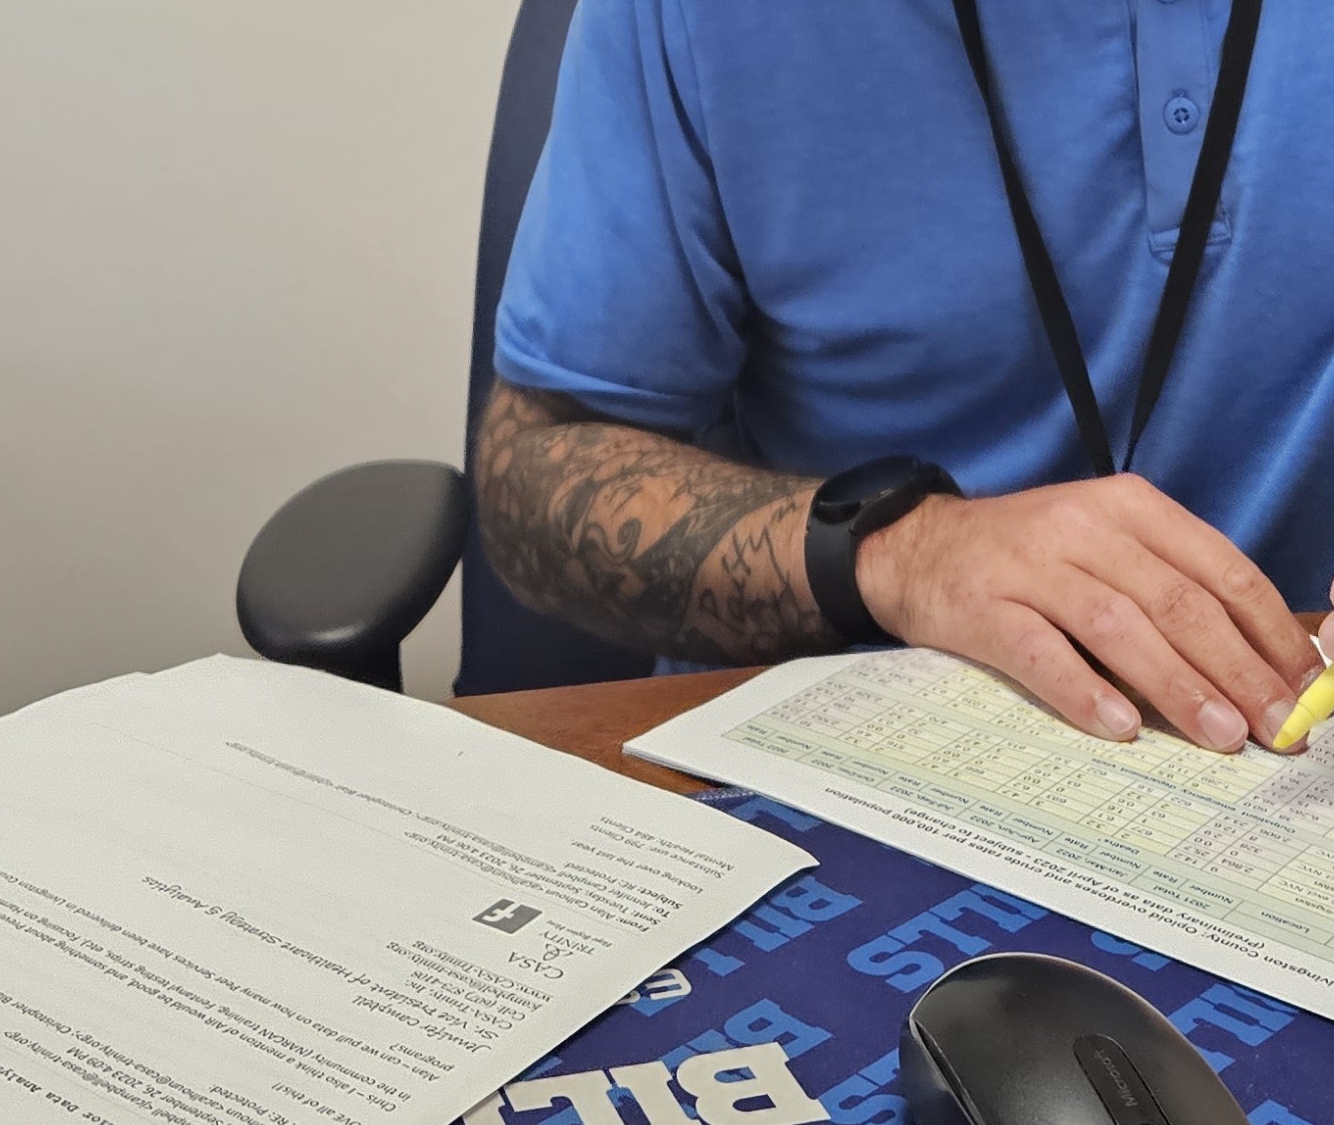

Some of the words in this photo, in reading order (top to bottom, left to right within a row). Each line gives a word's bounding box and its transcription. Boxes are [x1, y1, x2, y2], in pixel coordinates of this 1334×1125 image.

[897, 775, 922, 787] Rate
[824, 787, 894, 816] population
[929, 787, 970, 805] Number
[903, 807, 957, 831] change)
[979, 804, 1004, 817] Rate
[890, 813, 940, 835] 100,000
[969, 814, 996, 828] 2022
[1012, 817, 1054, 837] Number
[941, 832, 968, 845] per
[957, 828, 973, 838] to
[967, 841, 1003, 858] rates
[972, 833, 1025, 857] subject
[1063, 837, 1089, 850] Rate
[1055, 848, 1083, 861] 2022
[1098, 850, 1142, 870] Number
[1003, 855, 1044, 874] crude
[1032, 857, 1068, 874] 2023
[1042, 871, 1073, 885] and
[1066, 870, 1104, 887] April
[1152, 870, 1179, 884] Rate
[17, 880, 68, 907] Livingston
[141, 876, 210, 909] Analytics
[1073, 882, 1148, 914] overdoses
[1101, 884, 1120, 894] of
[1122, 891, 1141, 901] as
[1152, 884, 1181, 900] Total
[1189, 884, 1234, 905] Number
[64, 901, 79, 911] in
[544, 888, 590, 909] Calhoun
[1141, 898, 1174, 914] data
[1183, 896, 1211, 910] 2021
[72, 906, 123, 933] delivered
[588, 904, 617, 921] Alan
[218, 910, 283, 945] Strategy
[615, 917, 651, 933] From:
[1147, 911, 1199, 935] Opioid
[1175, 912, 1266, 950] (Preliminary
[1260, 911, 1311, 934] Location
[23, 926, 57, 944] about
[120, 929, 149, 947] been
[538, 930, 596, 956] TRINITY
[52, 939, 109, 971] something
[146, 942, 175, 960] have
[1200, 933, 1260, 959] County:
[171, 954, 217, 980] Services
[279, 941, 354, 979] Healthcare
[507, 950, 565, 980] CASA
[102, 967, 129, 981] and
[346, 972, 372, 986] of
[411, 939, 554, 1003] www.CASA-Trinity.org
[126, 977, 162, 997] good,
[213, 976, 242, 992] Peer
[404, 979, 428, 995] Inc.
[156, 993, 174, 1006] be
[239, 987, 272, 1005] many
[369, 982, 438, 1017] President
[9, 1001, 73, 1035] Christopher
[169, 1000, 207, 1021] would
[269, 1002, 297, 1019] how
[351, 994, 421, 1027] Campbell
[428, 988, 514, 1031] CASA-Trinity,
[203, 1016, 228, 1030] AIR
[295, 1013, 313, 1025] on
[436, 1011, 469, 1030] Vice
[221, 1026, 241, 1036] of
[311, 1022, 339, 1038] data
[419, 1023, 493, 1054] Jennifer
[473, 1025, 500, 1040] Sr.
[238, 1032, 288, 1060] mention
[334, 1034, 364, 1048] pull
[359, 1044, 380, 1057] we
[378, 1052, 403, 1065] can
[388, 1042, 456, 1073] programs?
[285, 1056, 297, 1064] a
[3, 1030, 165, 1111] <jcampbell@casa-trinity.org>
[294, 1060, 326, 1080] think
[410, 1065, 441, 1082] Alan
[1093, 1048, 1139, 1108] Microsoft
[324, 1075, 351, 1091] also
[44, 1091, 80, 1113] Data
[365, 1093, 397, 1113] Chris
